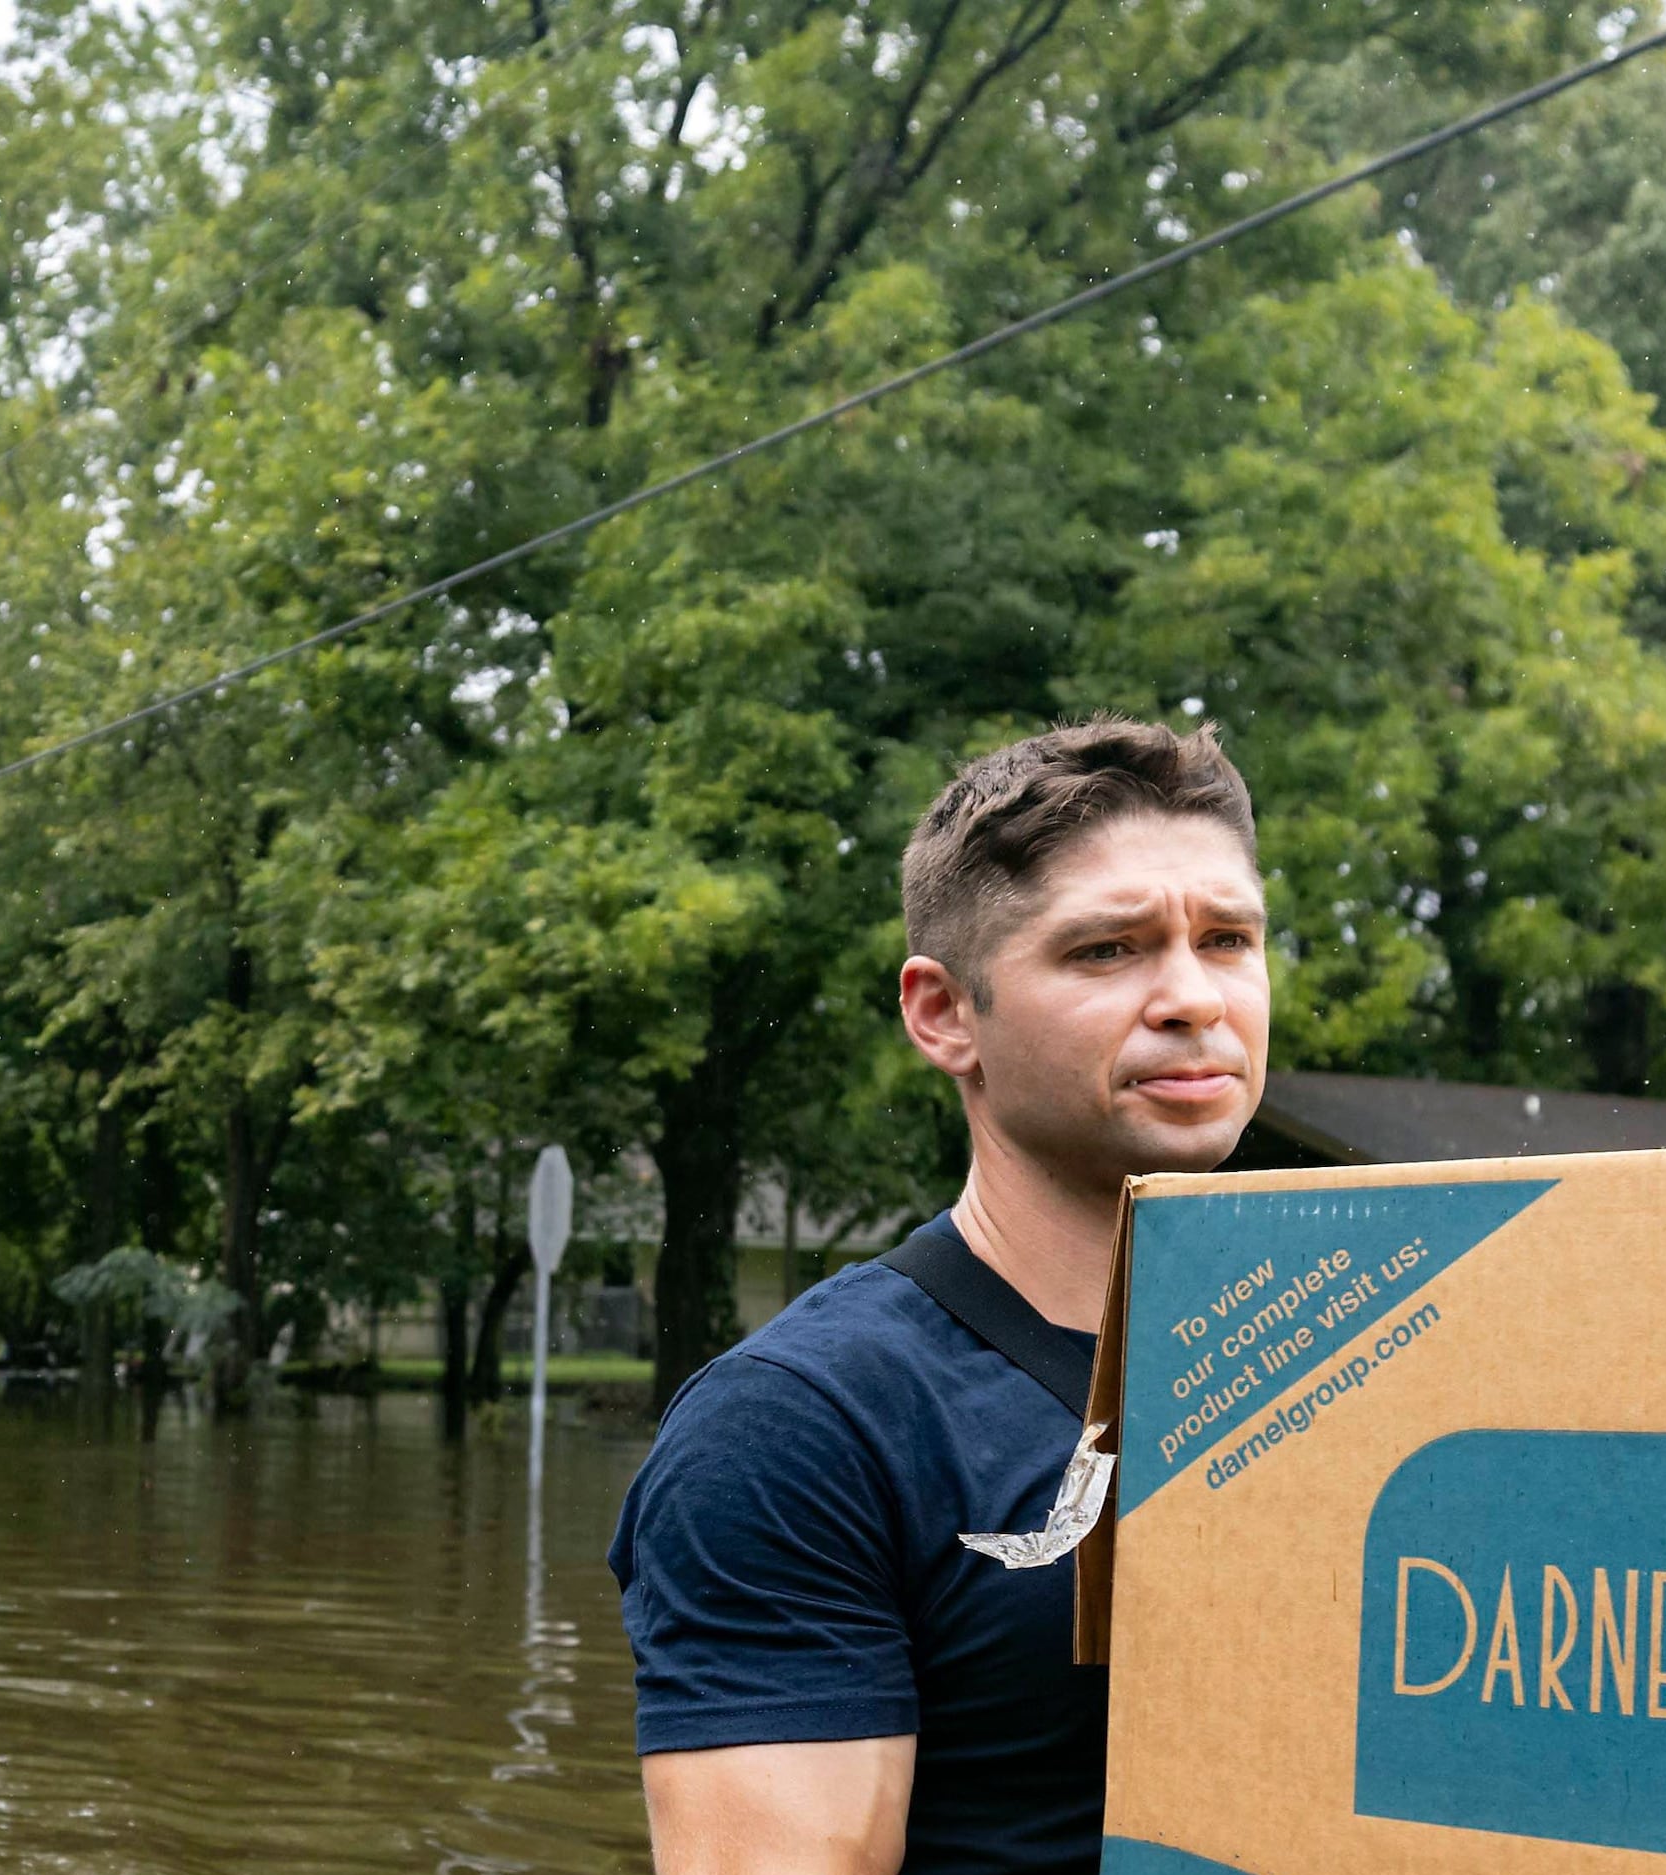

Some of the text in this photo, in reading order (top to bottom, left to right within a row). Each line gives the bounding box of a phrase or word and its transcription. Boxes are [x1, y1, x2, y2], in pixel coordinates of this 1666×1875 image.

[1157, 1237, 1430, 1463] product line visit us:
[1171, 1257, 1276, 1347] To view
[1172, 1246, 1352, 1400] our complete
[1205, 1301, 1442, 1490] darnelgroup.com
